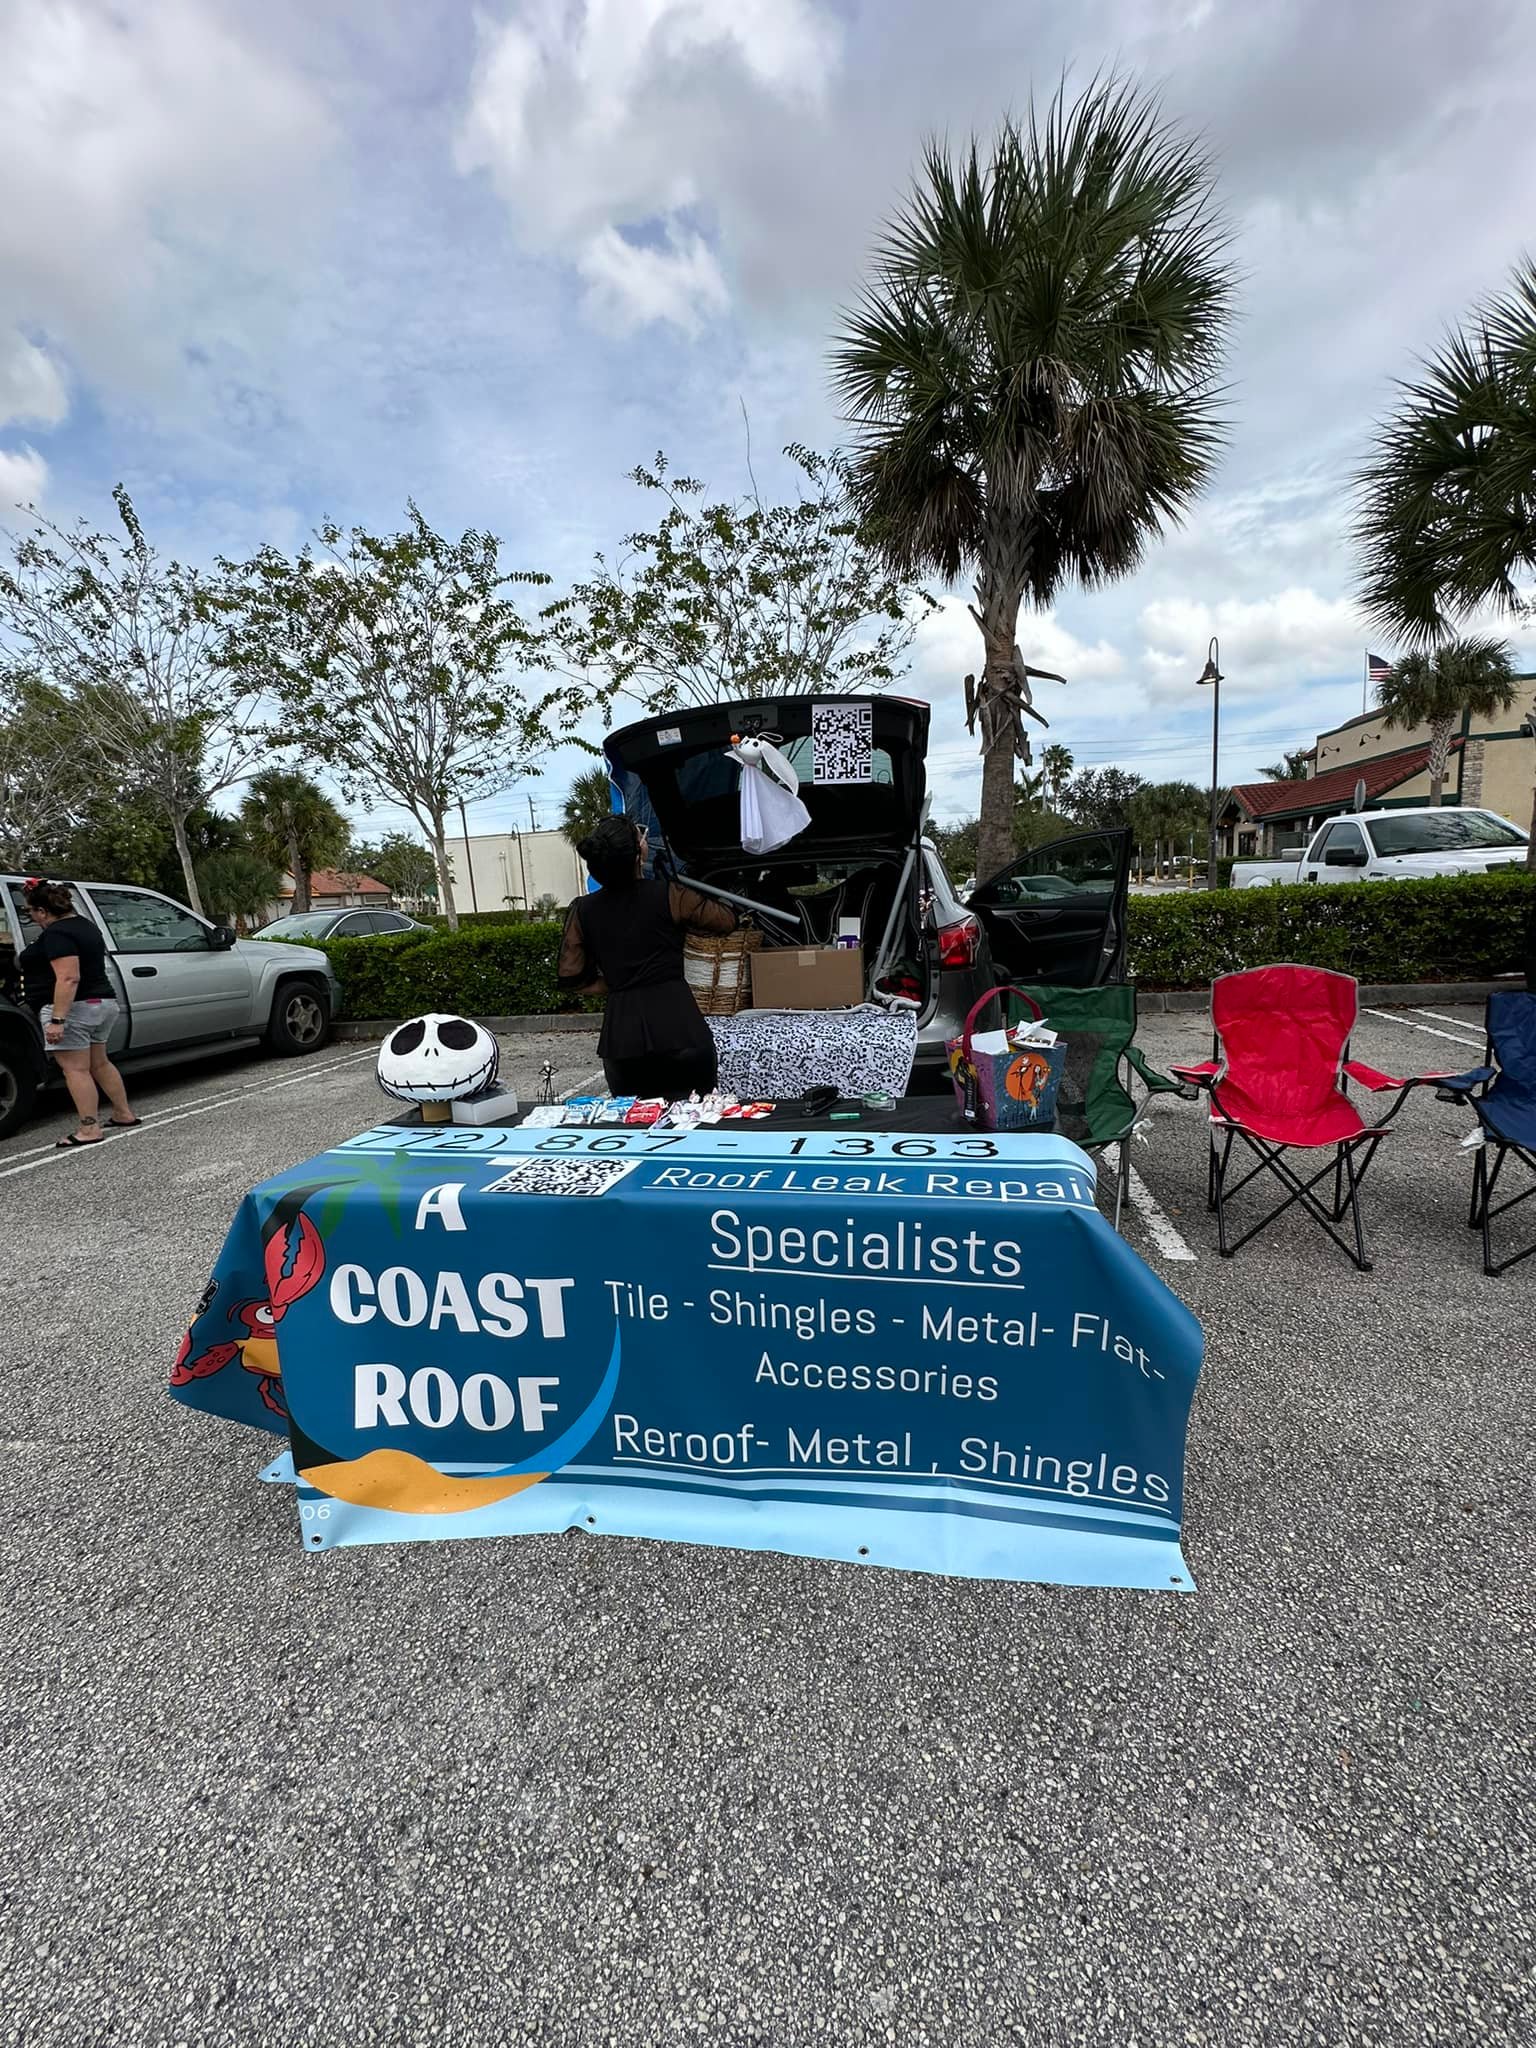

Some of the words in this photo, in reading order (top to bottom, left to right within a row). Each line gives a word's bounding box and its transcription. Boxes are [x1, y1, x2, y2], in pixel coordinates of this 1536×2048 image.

[352, 1130, 509, 1151] 772)
[534, 1133, 690, 1154] 867
[789, 1136, 1000, 1159] 1363
[416, 1182, 467, 1232] A
[653, 1167, 774, 1190] Roof
[782, 1170, 907, 1194] Leak
[711, 1209, 1023, 1278] Specialists
[329, 1263, 576, 1339] COAST
[604, 1280, 669, 1320] Tile
[709, 1289, 876, 1340] Shingles
[922, 1305, 1056, 1348] Metal-
[354, 1363, 560, 1433] ROOF
[755, 1351, 999, 1402] Accessories
[613, 1414, 770, 1464] Reroof-
[788, 1427, 912, 1467] Metal
[959, 1437, 1171, 1503] Shingles
